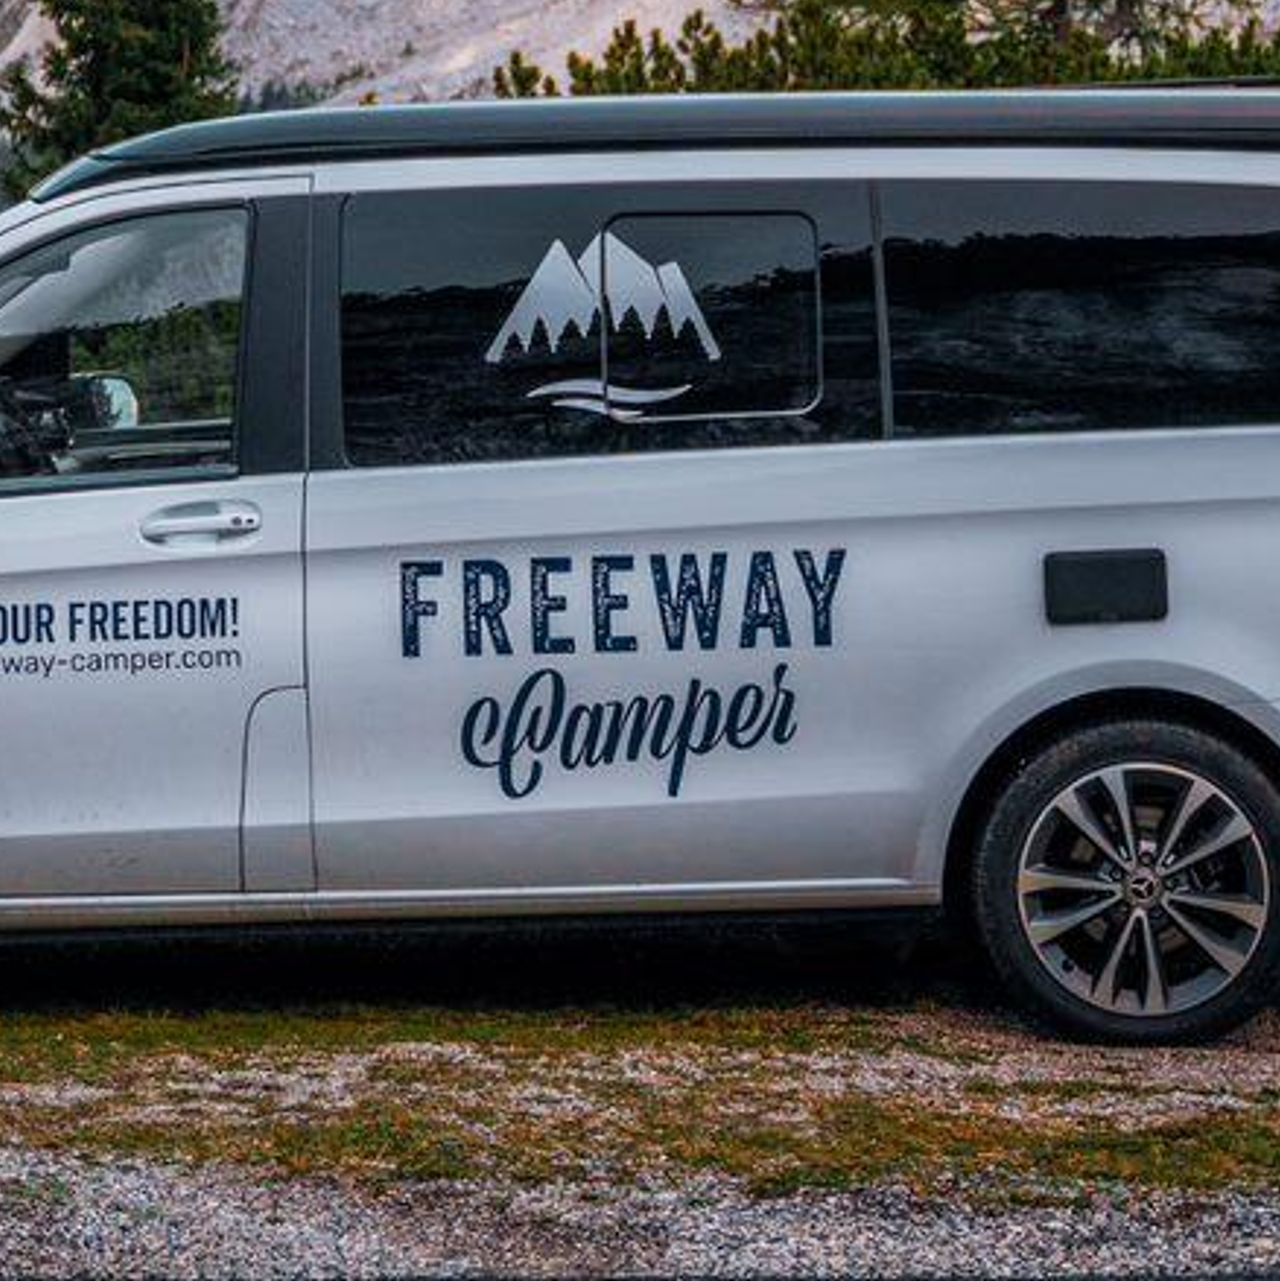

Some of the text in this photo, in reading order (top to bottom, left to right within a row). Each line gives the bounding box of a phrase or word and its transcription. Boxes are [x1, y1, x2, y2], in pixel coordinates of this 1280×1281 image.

[68, 596, 241, 642] FREEDOM!
[398, 548, 848, 658] FREEWAY
[460, 662, 798, 799] Camper
